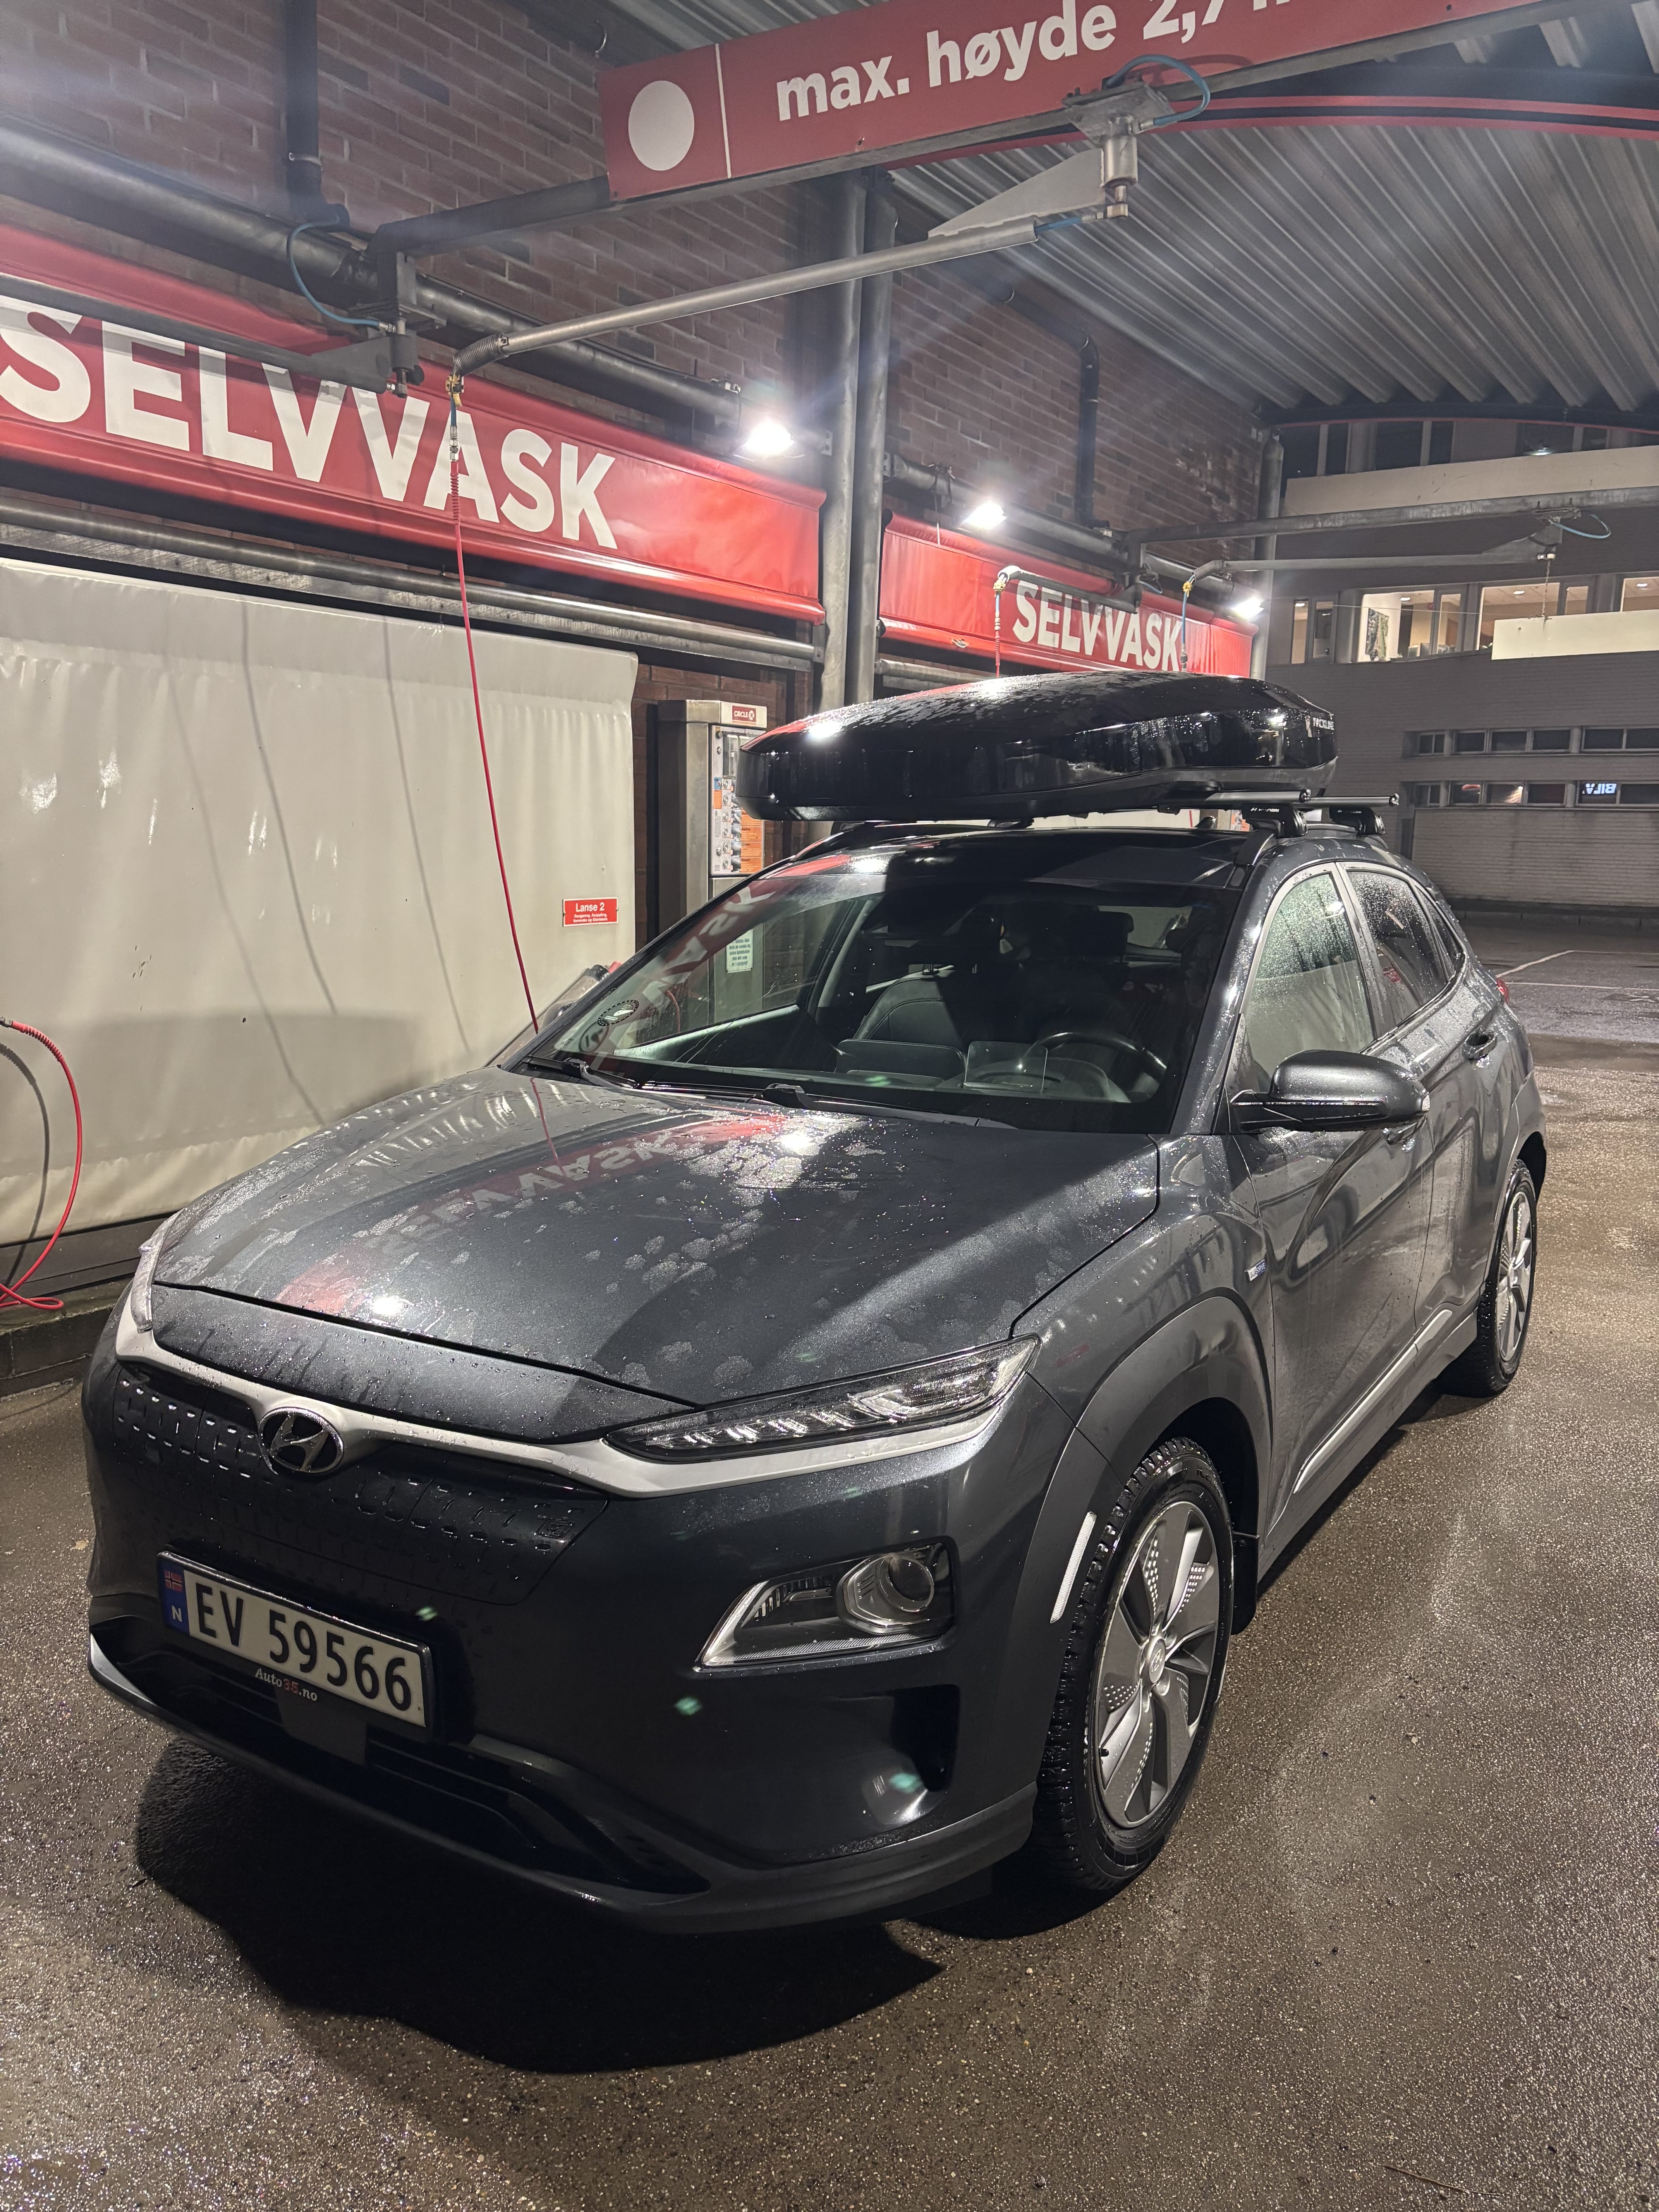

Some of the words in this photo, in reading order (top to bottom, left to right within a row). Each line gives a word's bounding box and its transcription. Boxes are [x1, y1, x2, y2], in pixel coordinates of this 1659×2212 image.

[776, 56, 910, 121] max.
[927, 0, 1117, 88] høyde
[0, 295, 617, 550] SELVVASK
[1012, 580, 1183, 671] SELVVASK
[733, 710, 749, 718] CIRCLE
[749, 711, 754, 720] K
[575, 903, 598, 912] Lanse
[599, 902, 605, 911] 2
[172, 1605, 182, 1623] N
[196, 1583, 244, 1647] EV
[269, 1609, 411, 1711] 59566
[255, 1668, 318, 1701] Auto35.no
